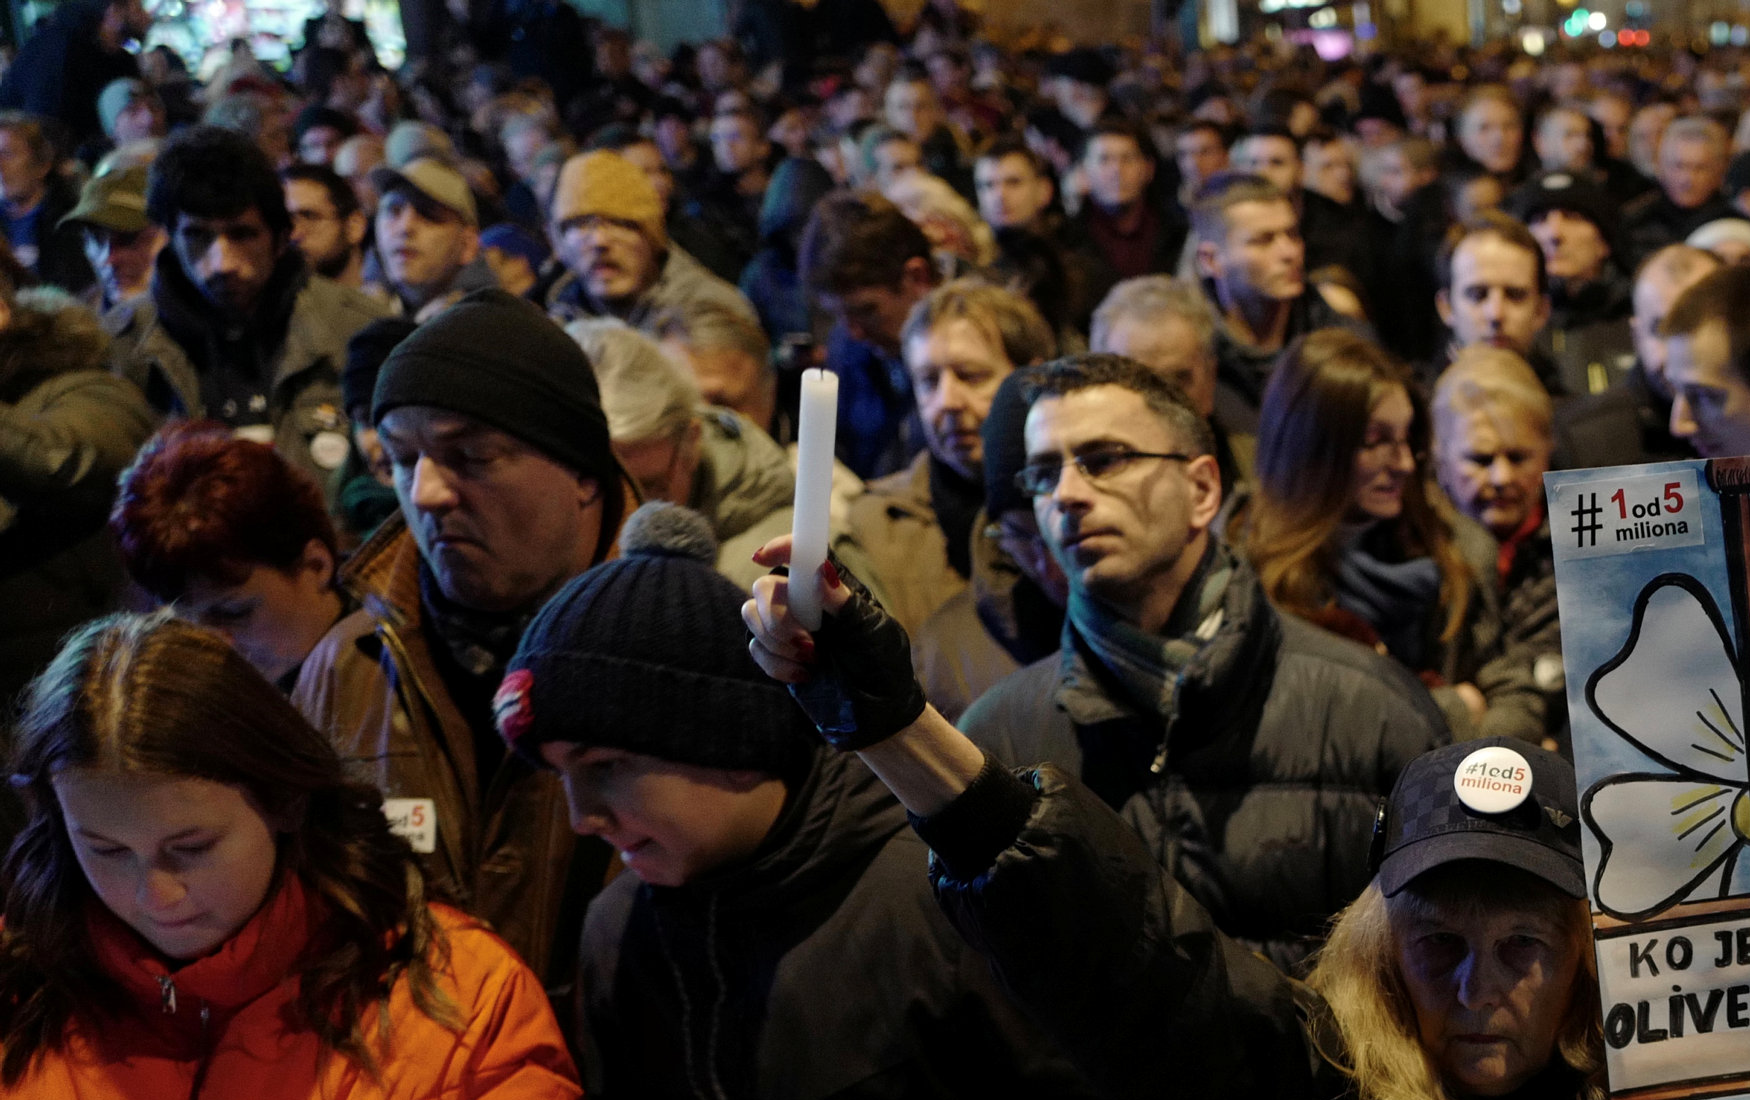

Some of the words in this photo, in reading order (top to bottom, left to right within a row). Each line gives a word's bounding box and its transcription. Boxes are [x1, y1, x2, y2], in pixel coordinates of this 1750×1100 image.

[1615, 520, 1689, 542] miliona
[1461, 776, 1523, 795] miliona
[1629, 934, 1694, 979] KO
